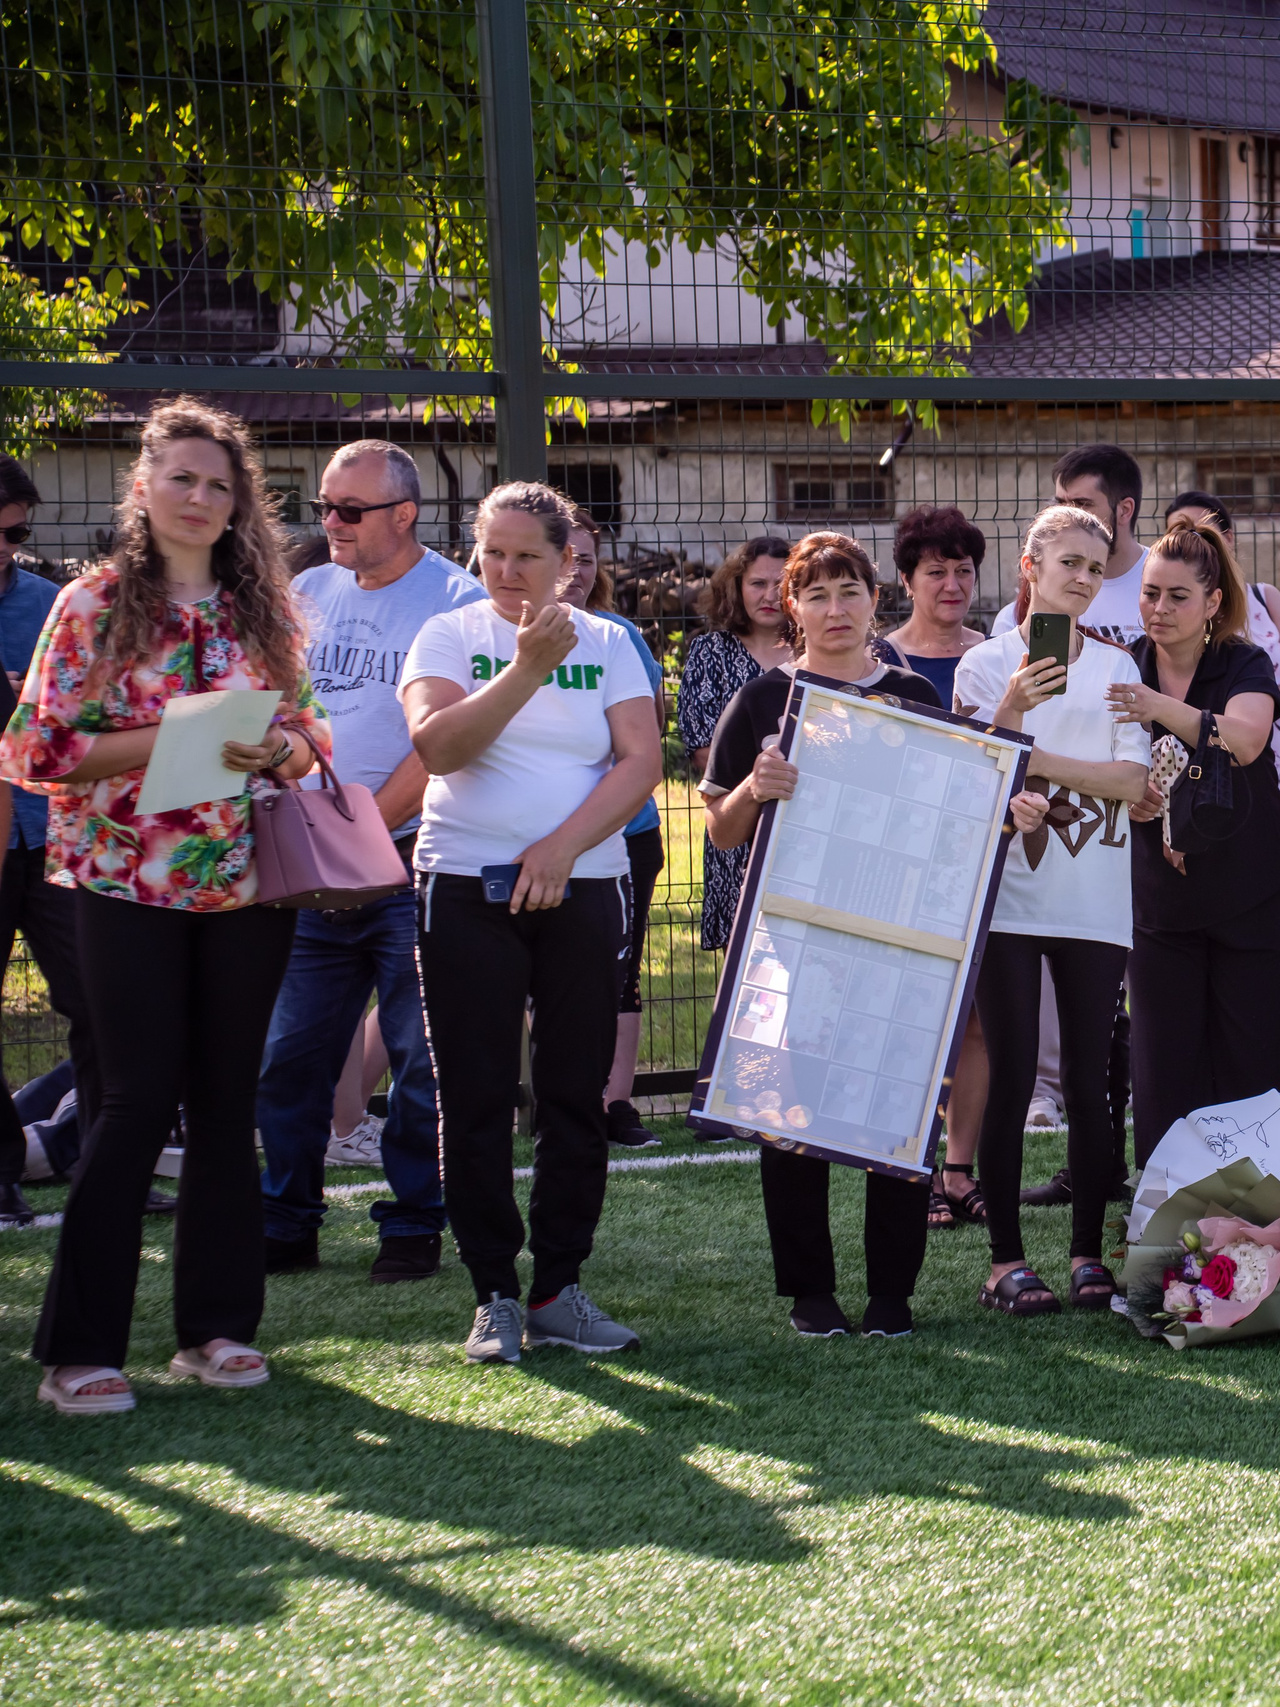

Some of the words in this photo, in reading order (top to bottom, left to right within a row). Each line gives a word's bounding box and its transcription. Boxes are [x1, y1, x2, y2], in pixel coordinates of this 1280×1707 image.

[305, 640, 359, 677] IAMI
[471, 654, 604, 690] aur
[312, 675, 366, 693] Florida
